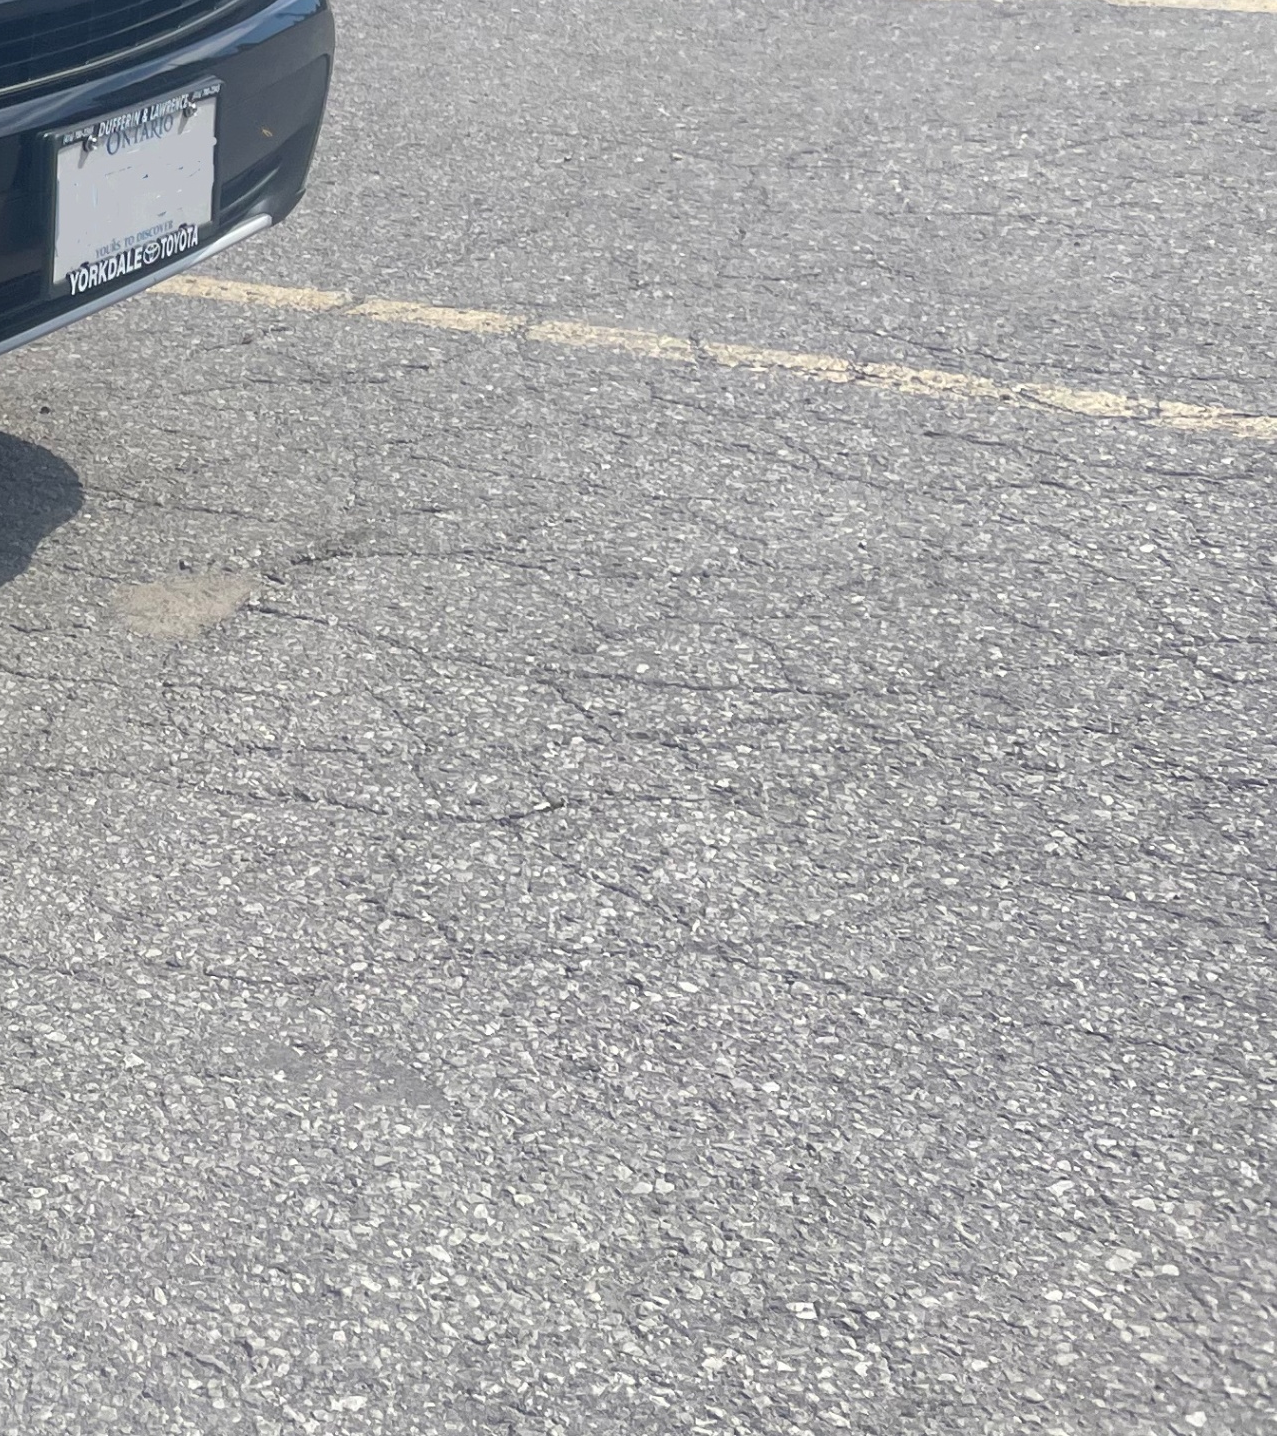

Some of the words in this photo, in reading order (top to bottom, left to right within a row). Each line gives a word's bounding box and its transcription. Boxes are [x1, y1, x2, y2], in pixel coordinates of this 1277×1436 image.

[98, 111, 140, 137] DUFFERIN
[142, 109, 148, 123] &
[150, 94, 189, 120] LAWRENCE
[106, 114, 173, 155] ONTARIO
[96, 241, 121, 256] YOURS
[124, 235, 135, 247] TO
[137, 220, 173, 240] DISCOVER
[69, 247, 143, 295] YORKDALE
[160, 225, 198, 259] TOYOTA
